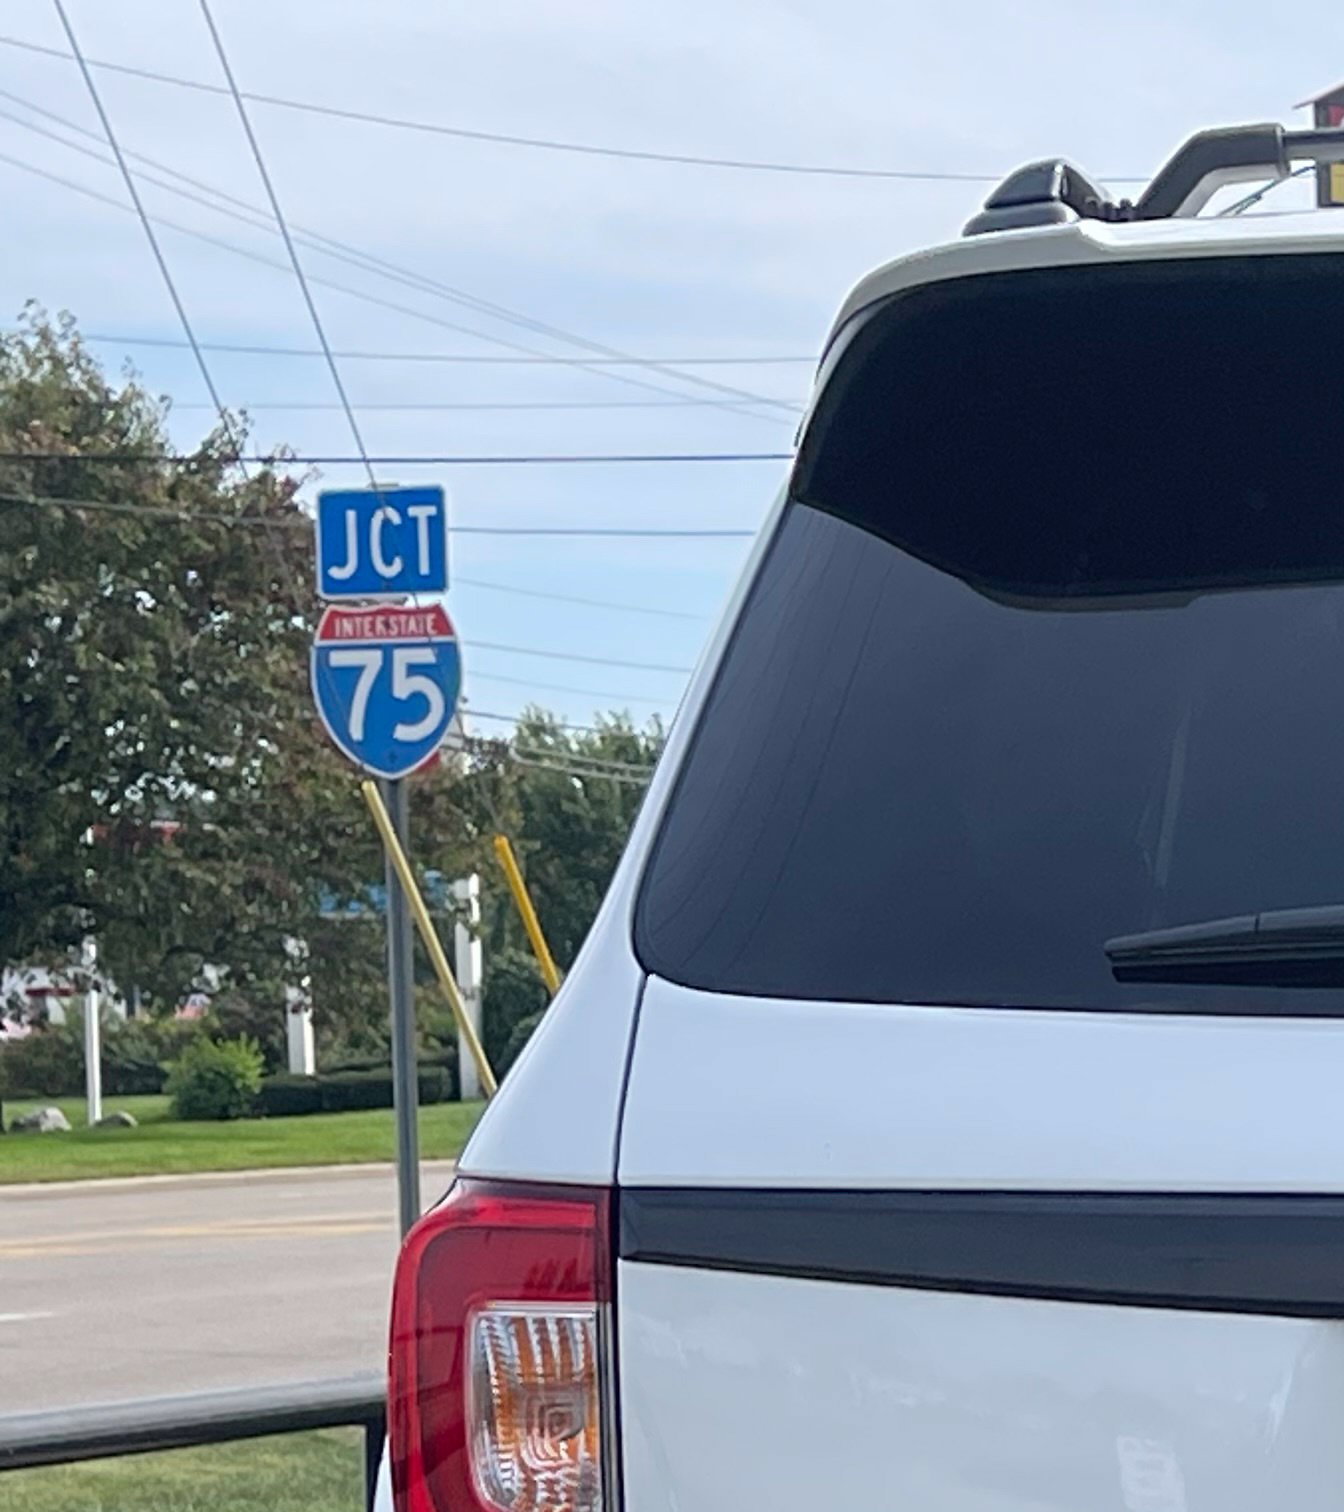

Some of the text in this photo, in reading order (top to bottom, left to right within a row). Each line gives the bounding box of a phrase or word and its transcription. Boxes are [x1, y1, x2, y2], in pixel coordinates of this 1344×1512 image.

[327, 504, 438, 580] JCT
[334, 613, 437, 638] INTERSTATE
[328, 647, 446, 742] 75
